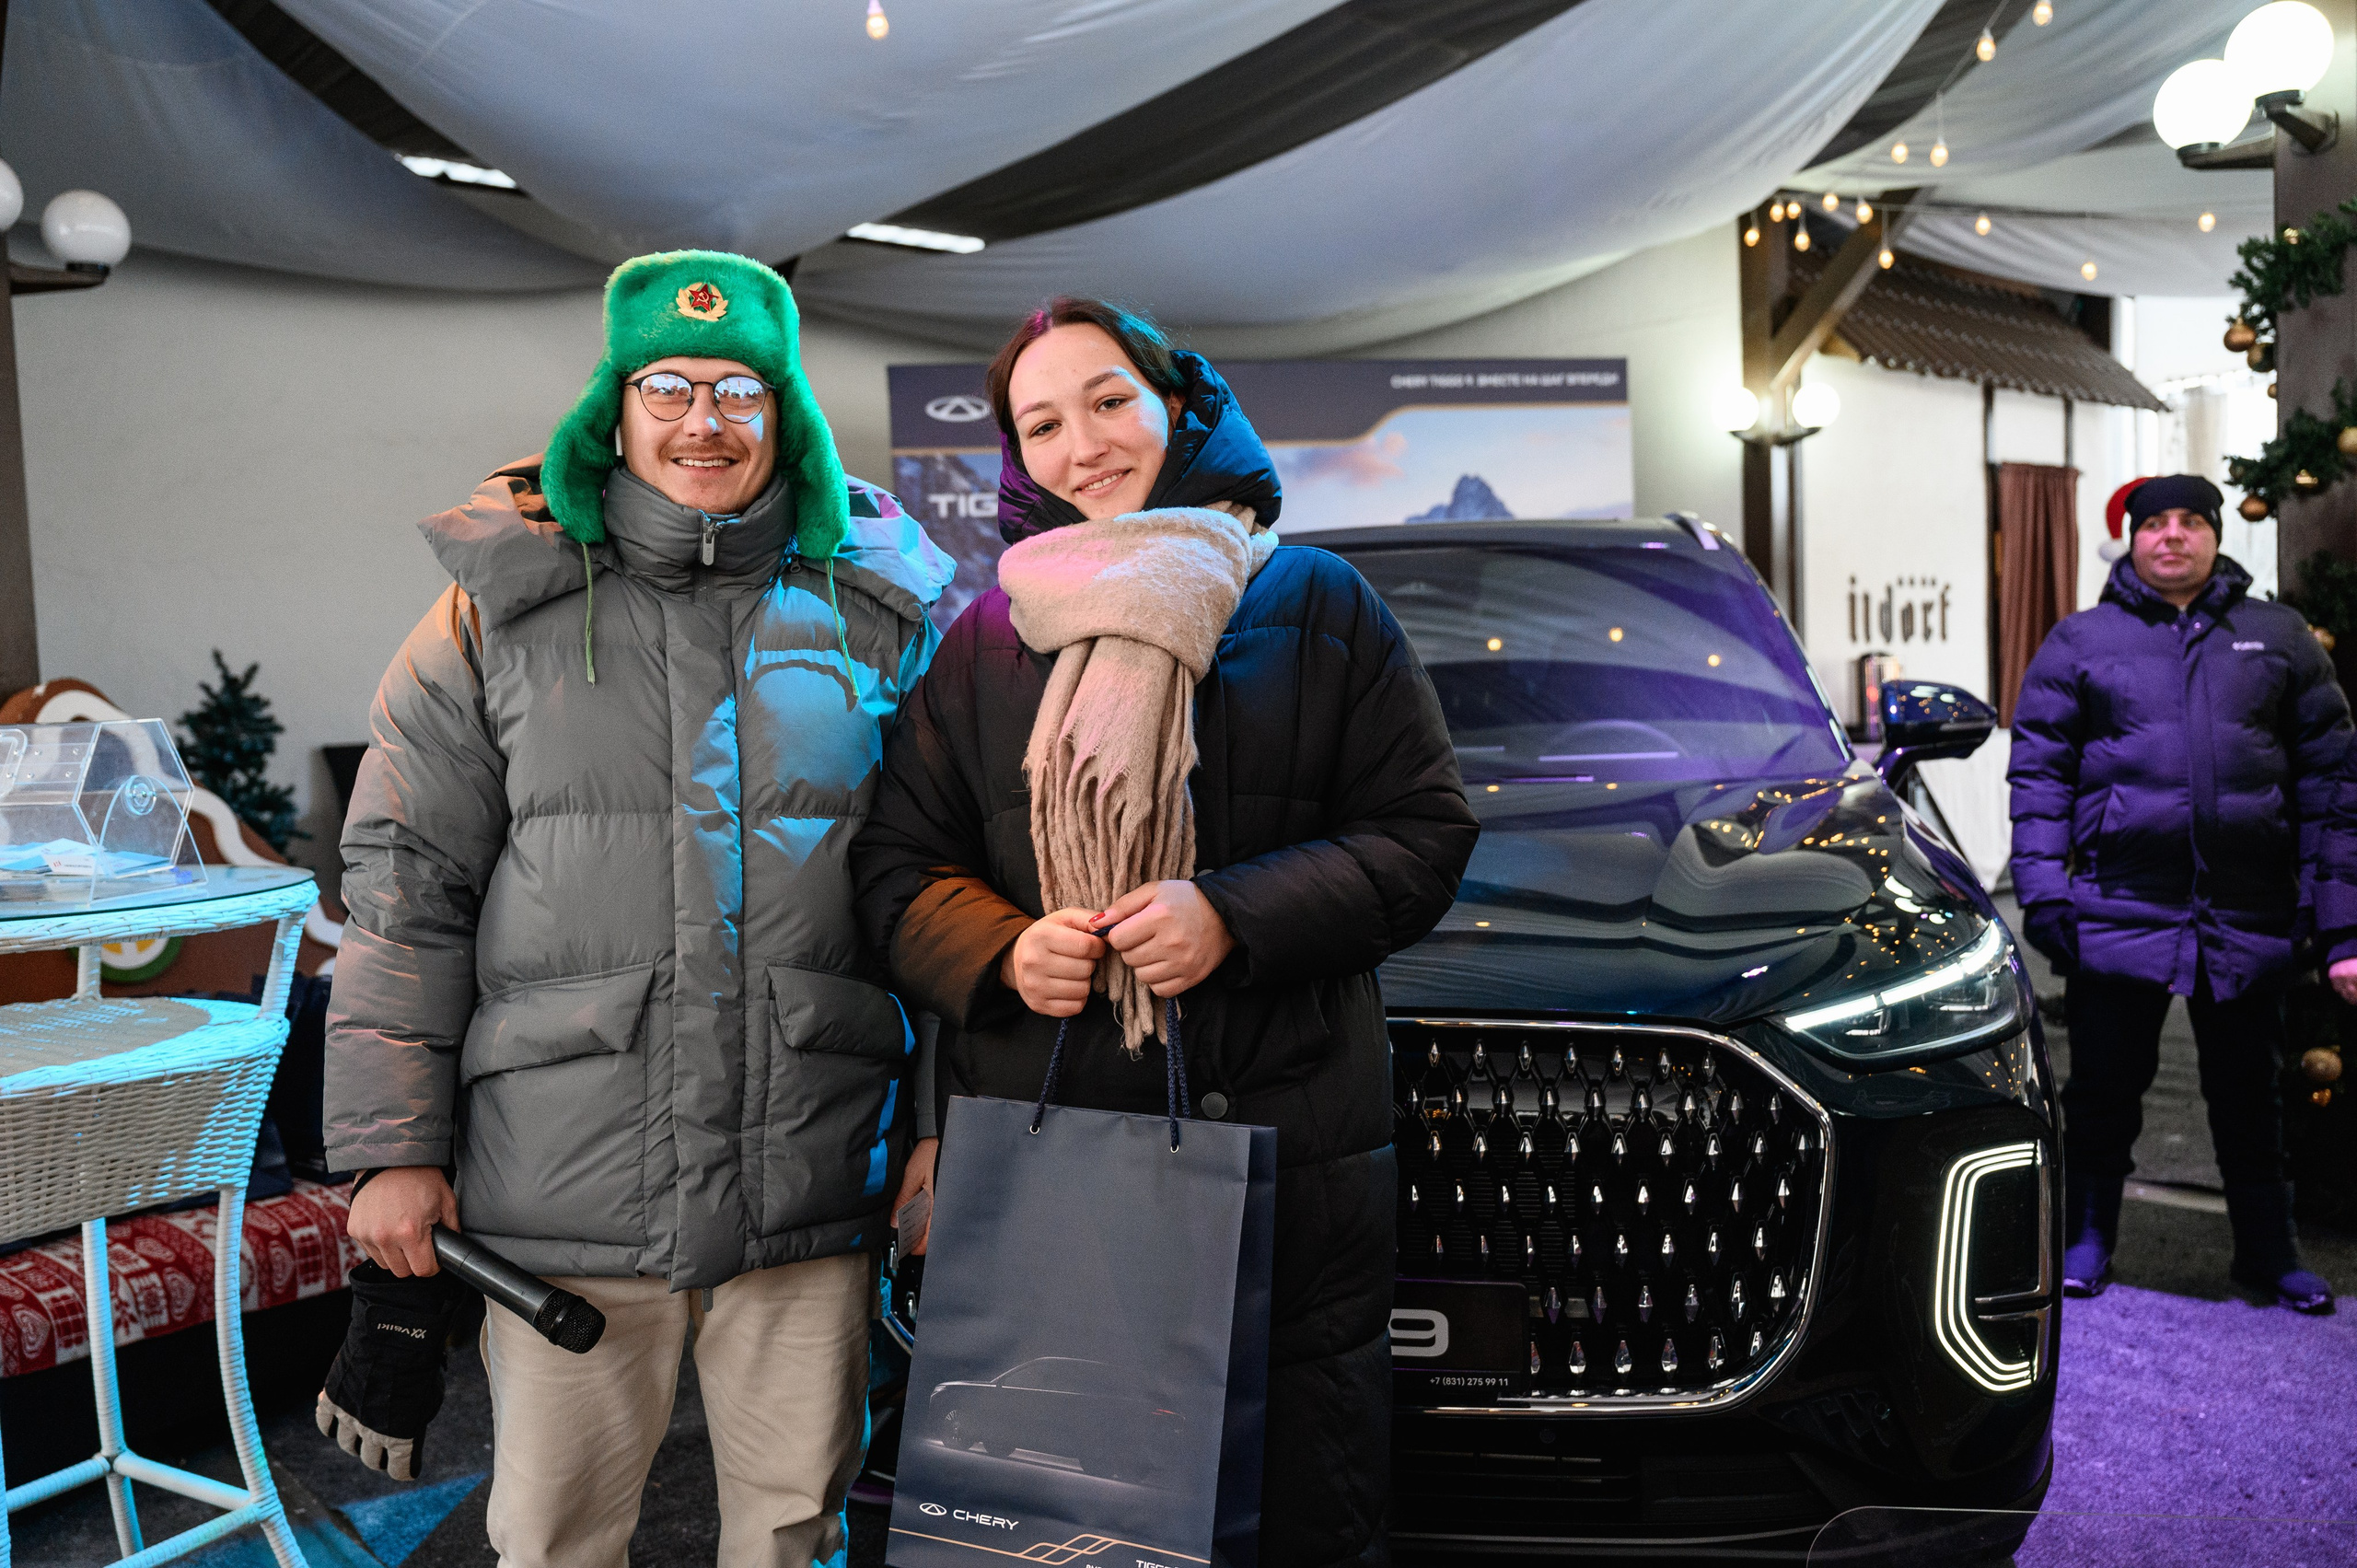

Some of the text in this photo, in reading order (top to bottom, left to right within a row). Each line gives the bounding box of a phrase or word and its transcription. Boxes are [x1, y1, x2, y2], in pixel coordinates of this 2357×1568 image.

[1387, 1308, 1449, 1357] 9
[1430, 1376, 1509, 1387] +7 (831) 275 99 11
[953, 1509, 1019, 1530] CHERY
